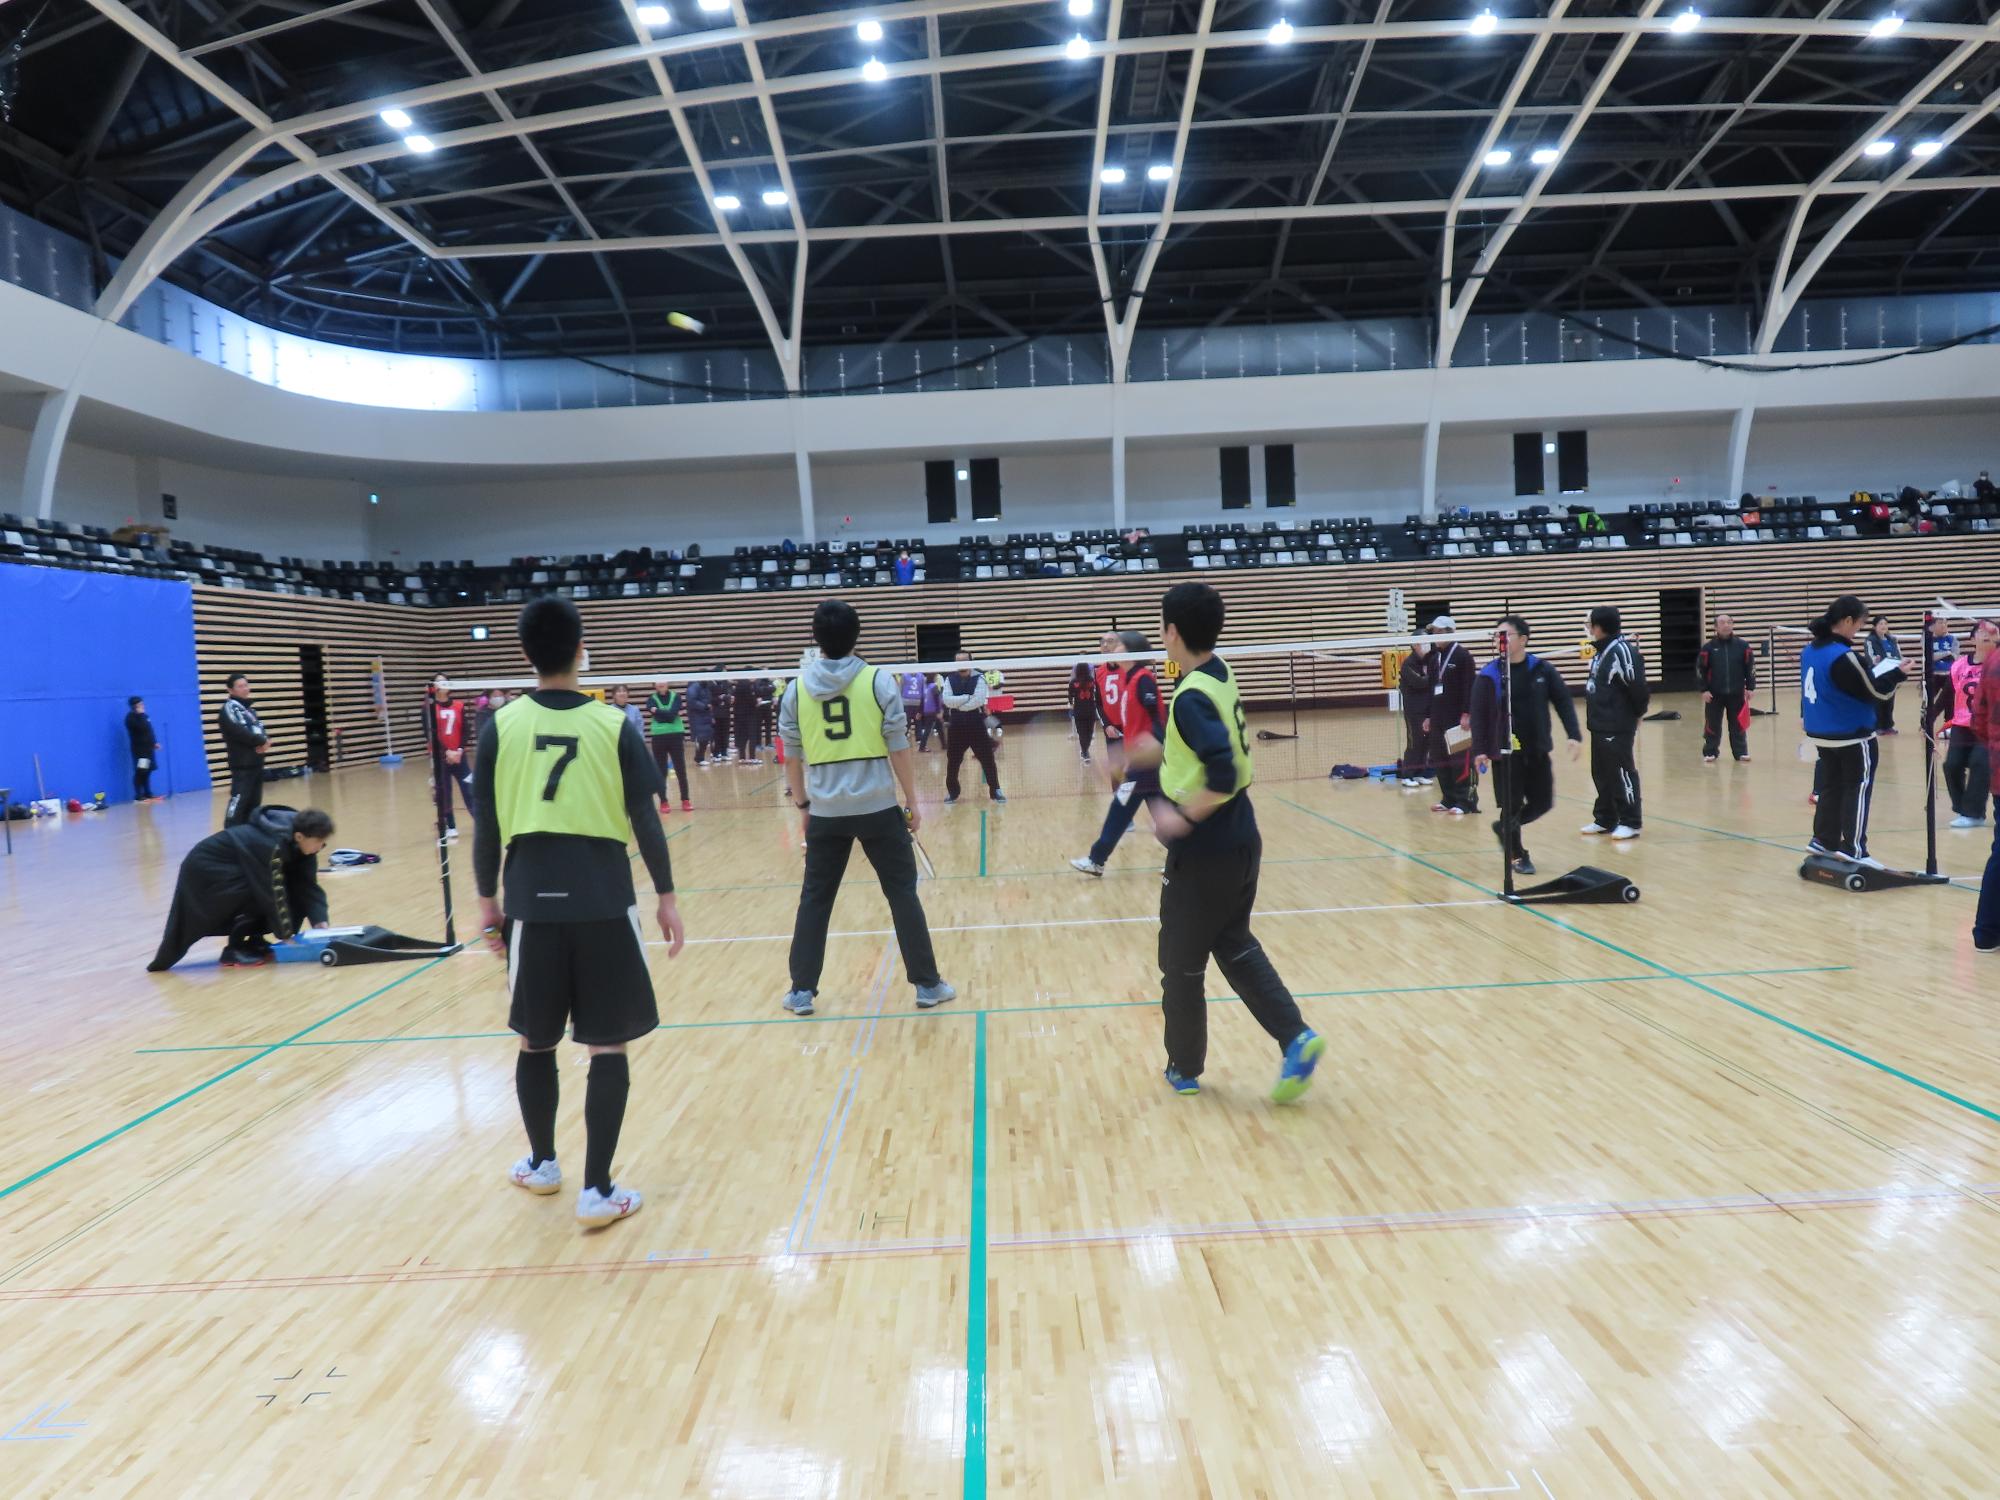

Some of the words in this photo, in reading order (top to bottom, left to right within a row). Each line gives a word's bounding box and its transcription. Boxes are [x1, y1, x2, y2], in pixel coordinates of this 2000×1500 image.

[1394, 592, 1399, 608] E
[1168, 661, 1176, 675] 0
[1391, 653, 1397, 681] 3
[910, 676, 919, 691] 3
[1105, 674, 1120, 705] 5
[1804, 666, 1817, 704] 4
[439, 708, 456, 736] 7
[822, 695, 852, 740] 9
[534, 734, 578, 801] 7
